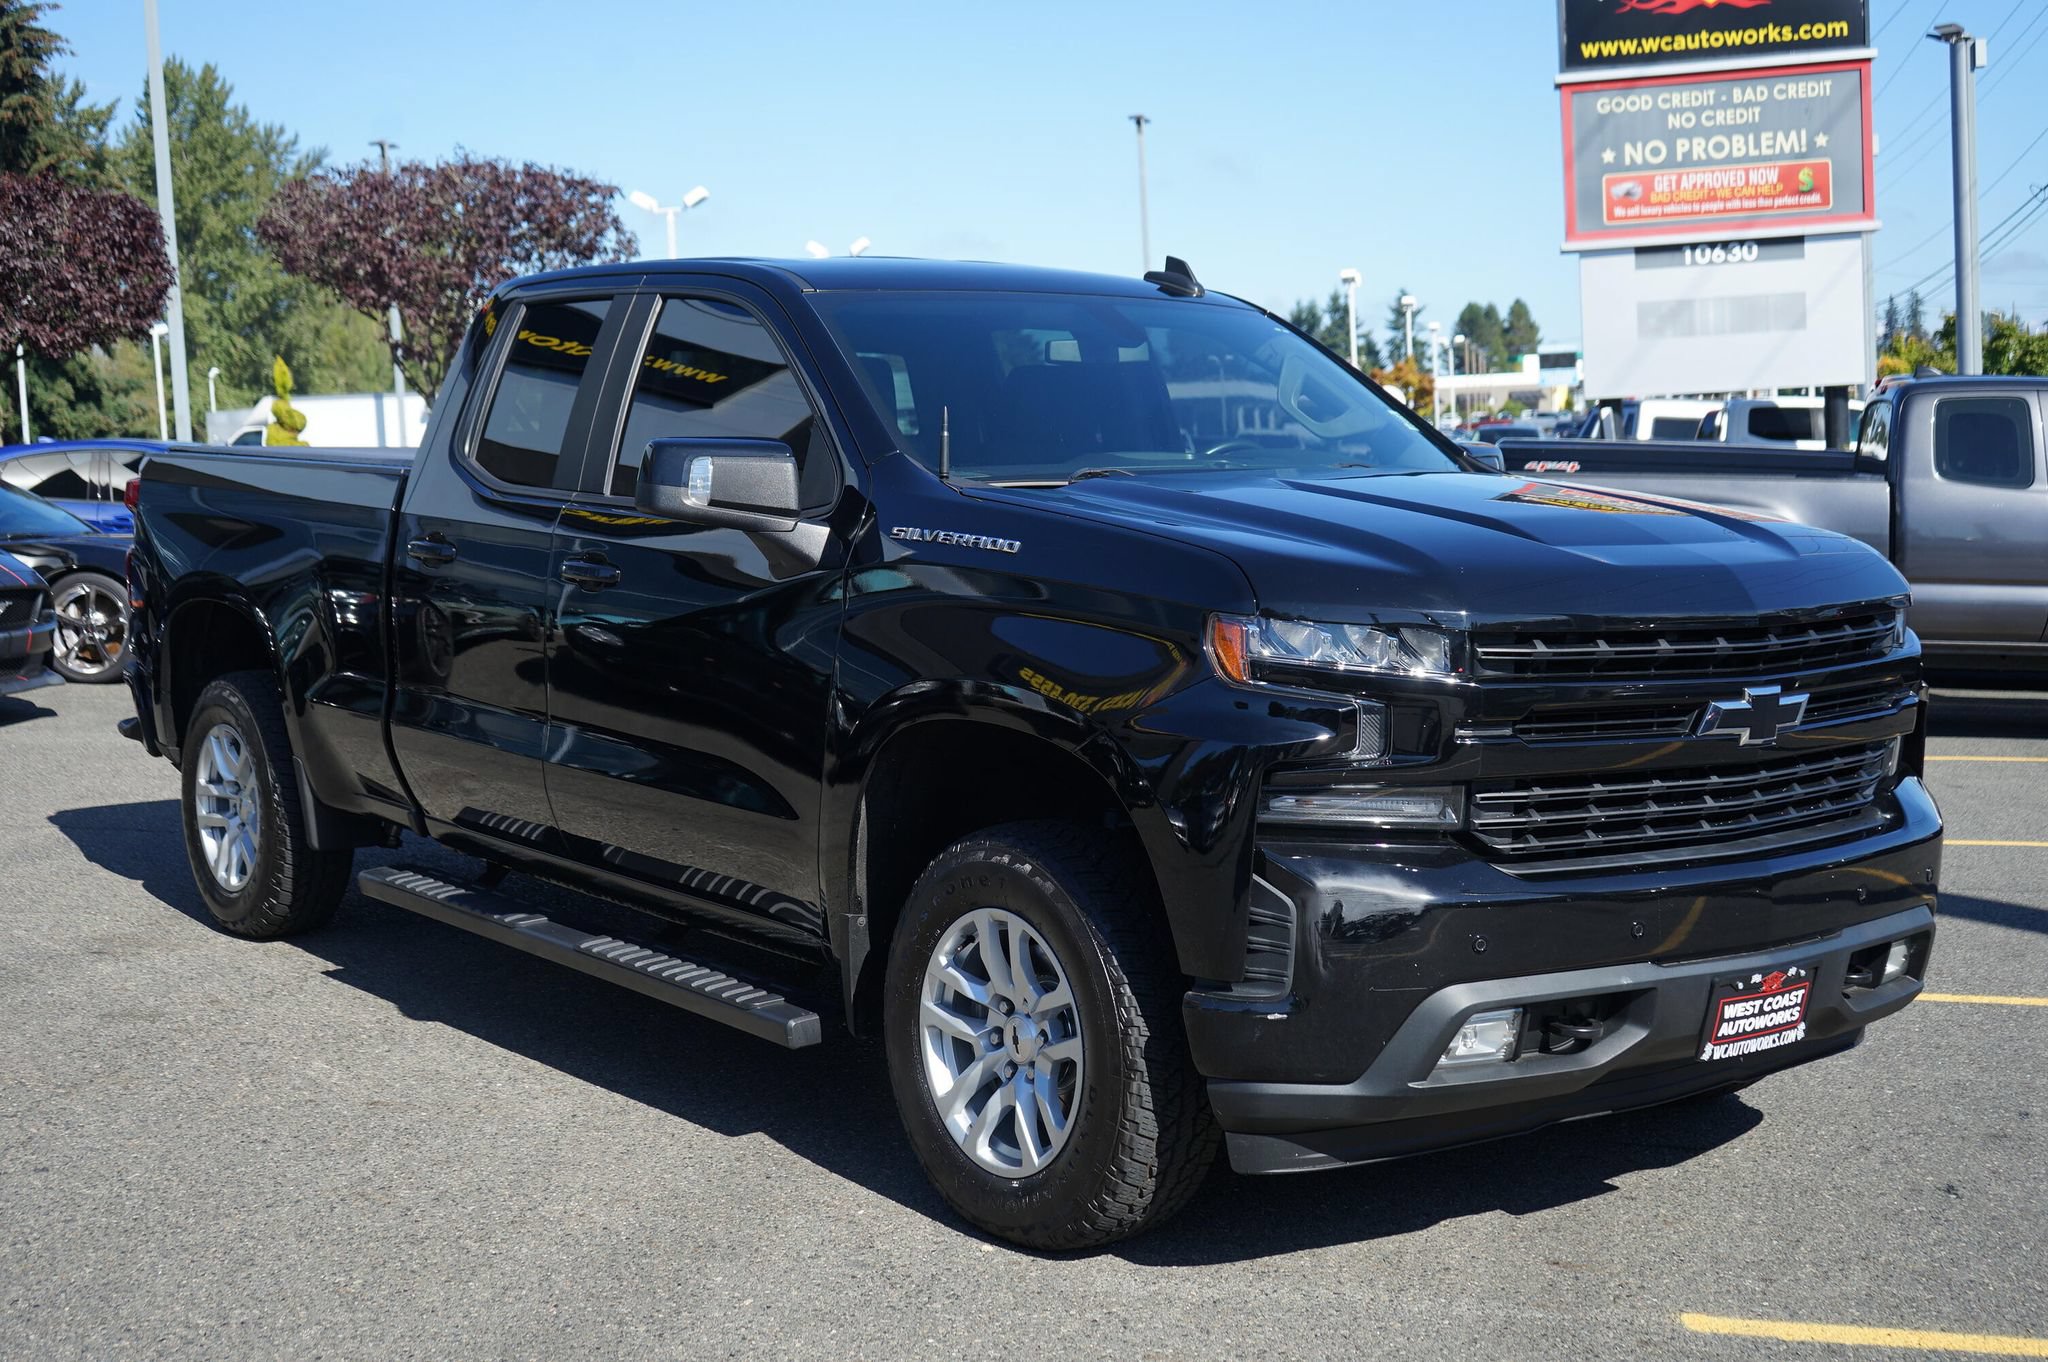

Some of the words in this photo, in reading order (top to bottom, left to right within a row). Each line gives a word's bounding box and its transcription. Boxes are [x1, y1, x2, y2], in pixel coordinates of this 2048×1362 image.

[1580, 20, 1849, 59] www.wcautoworks.com
[1596, 95, 1653, 114] GOOD
[1657, 88, 1716, 110] CREDIT
[1732, 85, 1769, 104] BAD
[1773, 79, 1832, 100] CREDIT
[1667, 111, 1697, 130] NO
[1700, 106, 1761, 127] CREDIT
[1623, 139, 1668, 166] NO
[1676, 128, 1808, 162] PROBLEM!
[1650, 191, 1671, 204] BAD
[1673, 189, 1709, 203] CREDIT
[1715, 187, 1733, 199] WE
[1734, 185, 1755, 198] CAN
[1757, 182, 1784, 196] HELP
[1654, 173, 1678, 192] GET
[1681, 168, 1745, 190] APPROVED
[1749, 166, 1779, 185] NOW
[1682, 240, 1759, 266] 10630
[890, 526, 1021, 554] SILVERADO
[1724, 999, 1763, 1019] WEST
[1763, 989, 1806, 1012] COAST
[1717, 1006, 1801, 1037] AUTOWORKS
[1712, 1028, 1798, 1060] WCAUTOWORKS.COM
